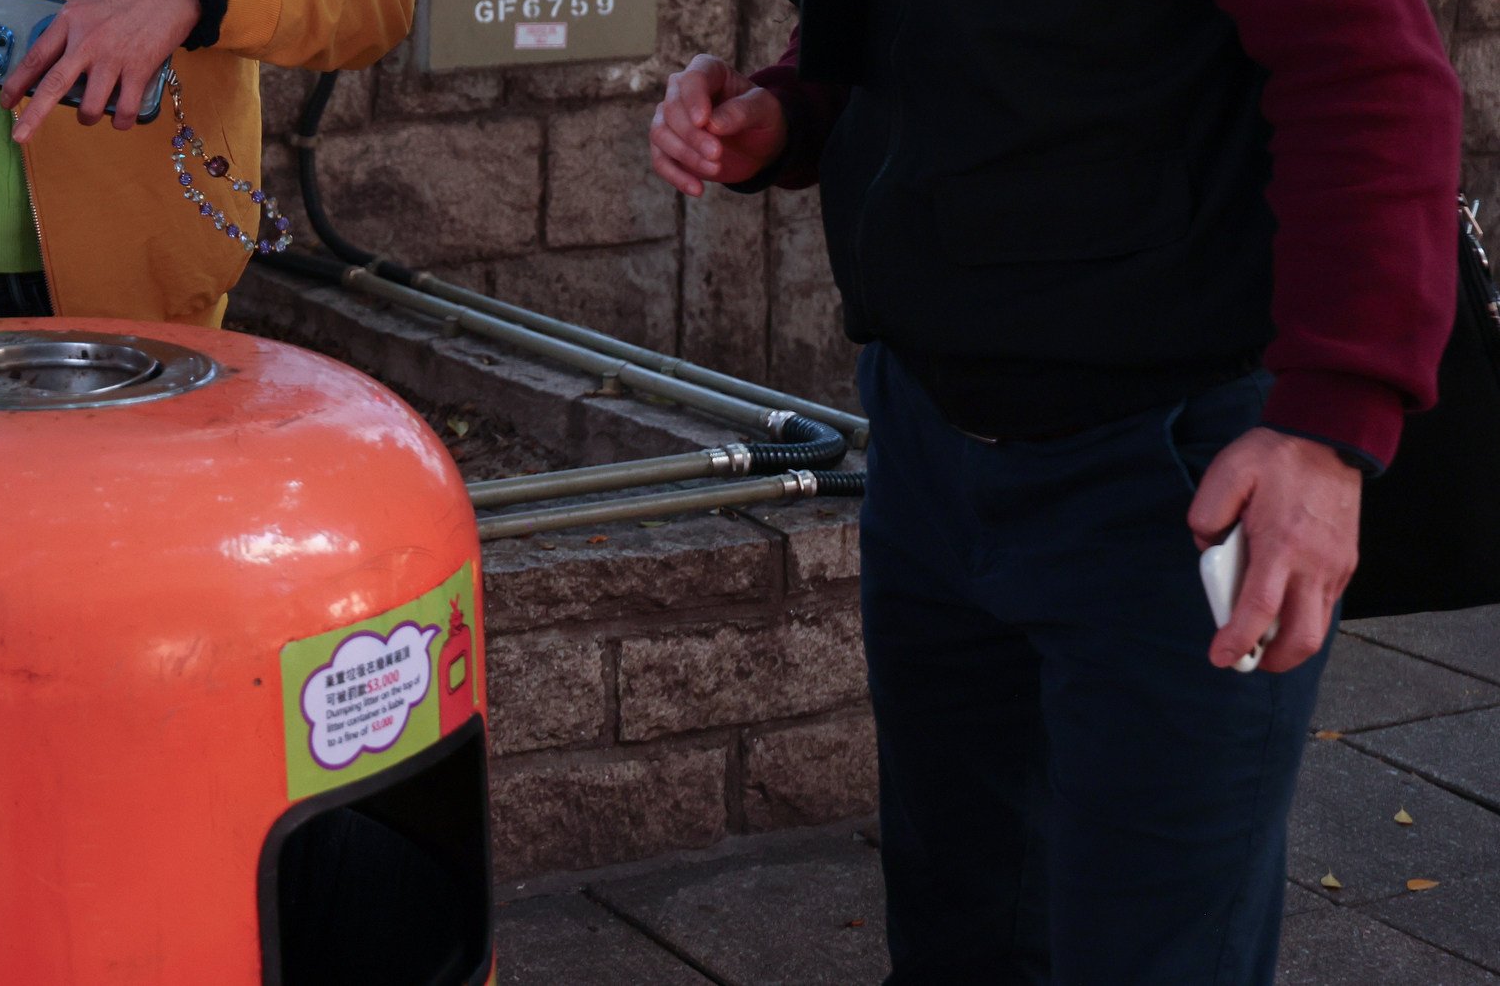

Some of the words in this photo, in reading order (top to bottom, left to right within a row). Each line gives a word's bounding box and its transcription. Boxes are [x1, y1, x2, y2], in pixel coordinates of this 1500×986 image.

[326, 702, 362, 720] Dumping
[363, 695, 379, 707] litter
[380, 691, 390, 700] on
[391, 685, 402, 695] the
[403, 680, 414, 691] top
[414, 674, 420, 685] of
[327, 721, 344, 733] litter
[347, 709, 380, 727] container
[388, 697, 405, 711] liable
[327, 739, 336, 747] to
[344, 731, 359, 742] fine
[361, 725, 369, 736] of
